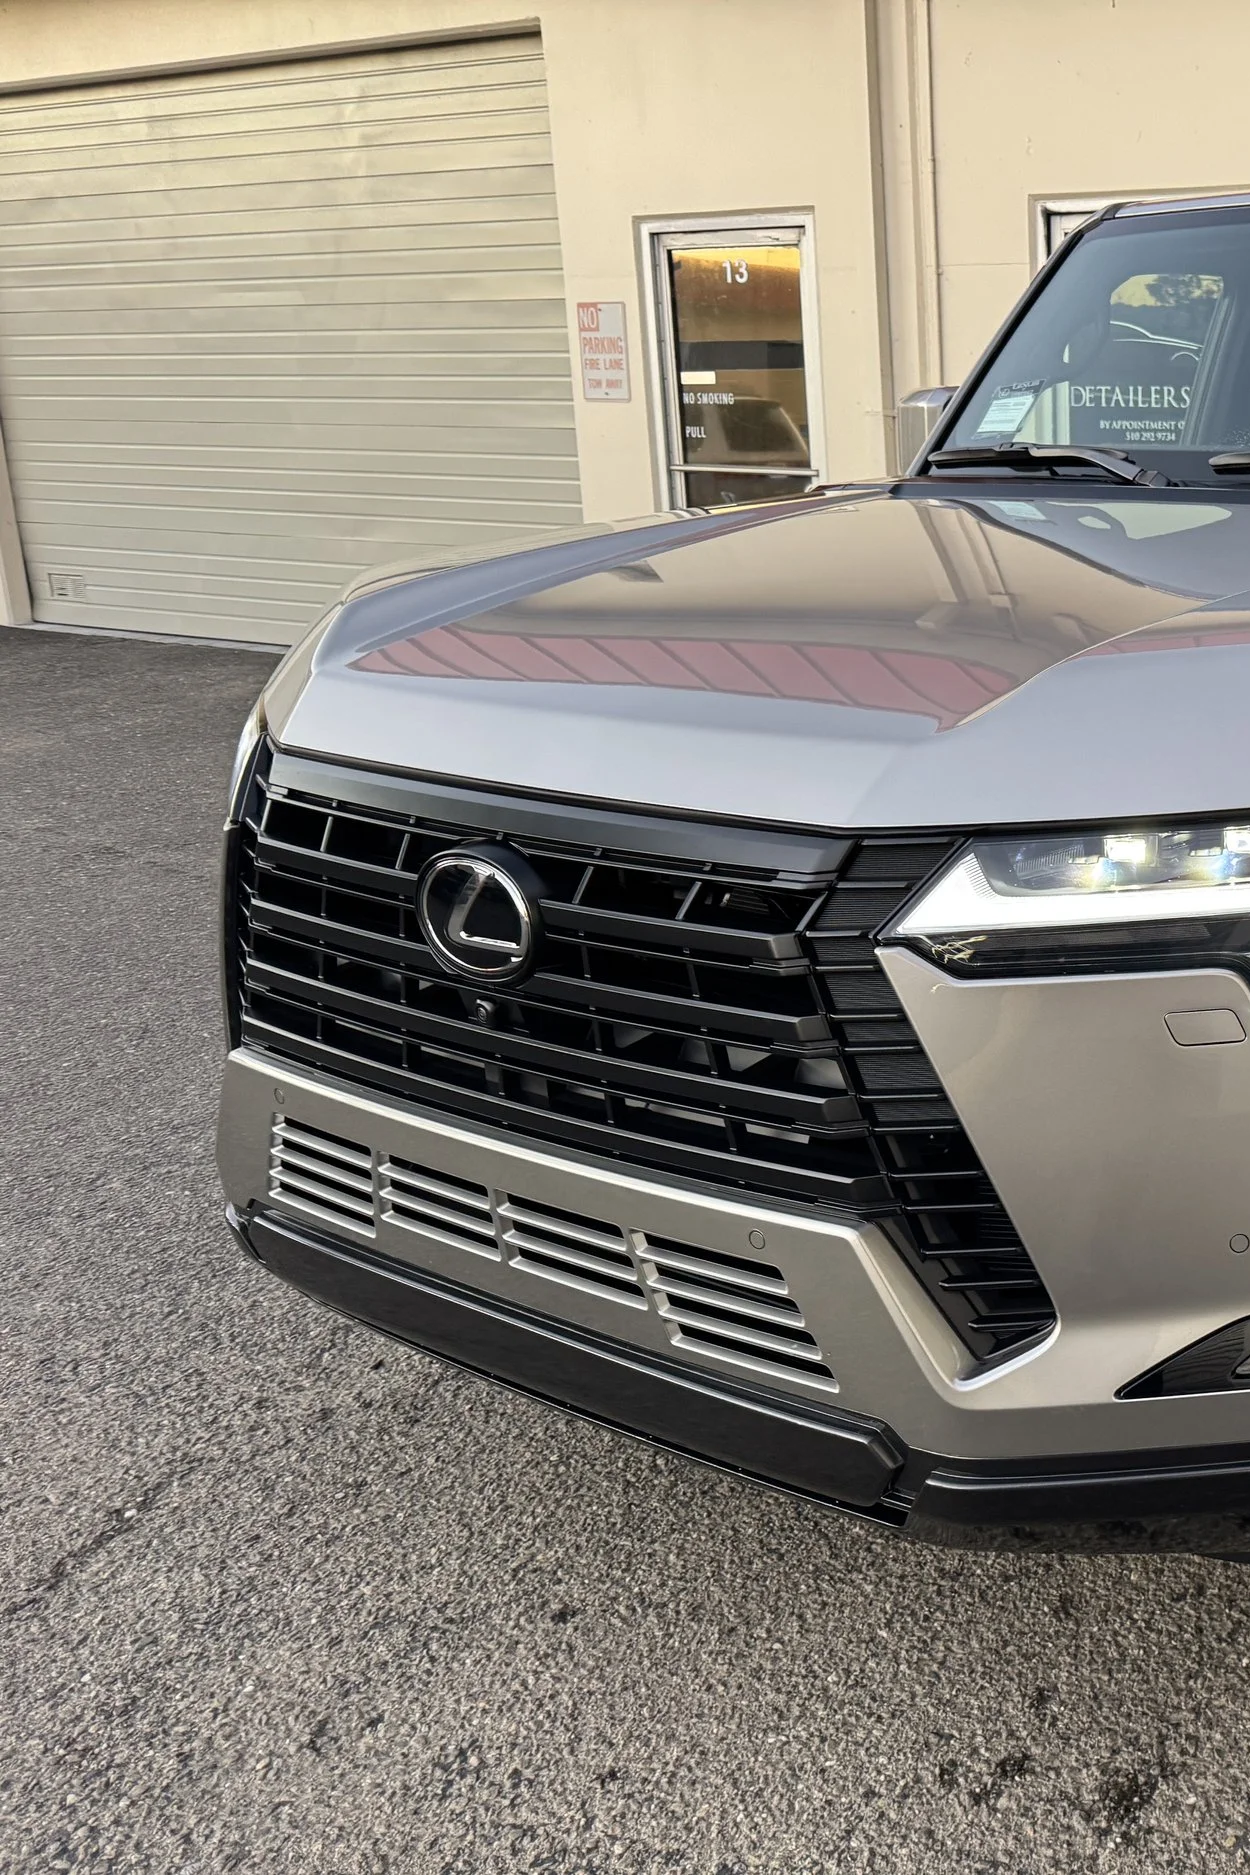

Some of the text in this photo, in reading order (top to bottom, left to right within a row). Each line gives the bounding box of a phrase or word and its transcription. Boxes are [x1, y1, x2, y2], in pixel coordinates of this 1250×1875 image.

[722, 259, 749, 284] 13
[579, 306, 598, 329] NO
[582, 336, 624, 355] PARKING
[584, 358, 625, 371] FIRE LANE
[683, 392, 735, 405] NO SMOKING
[1070, 385, 1191, 408] DETAILERS
[685, 426, 707, 438] PULL
[1100, 420, 1110, 430] BY
[1111, 420, 1177, 430] APPOINTMENT
